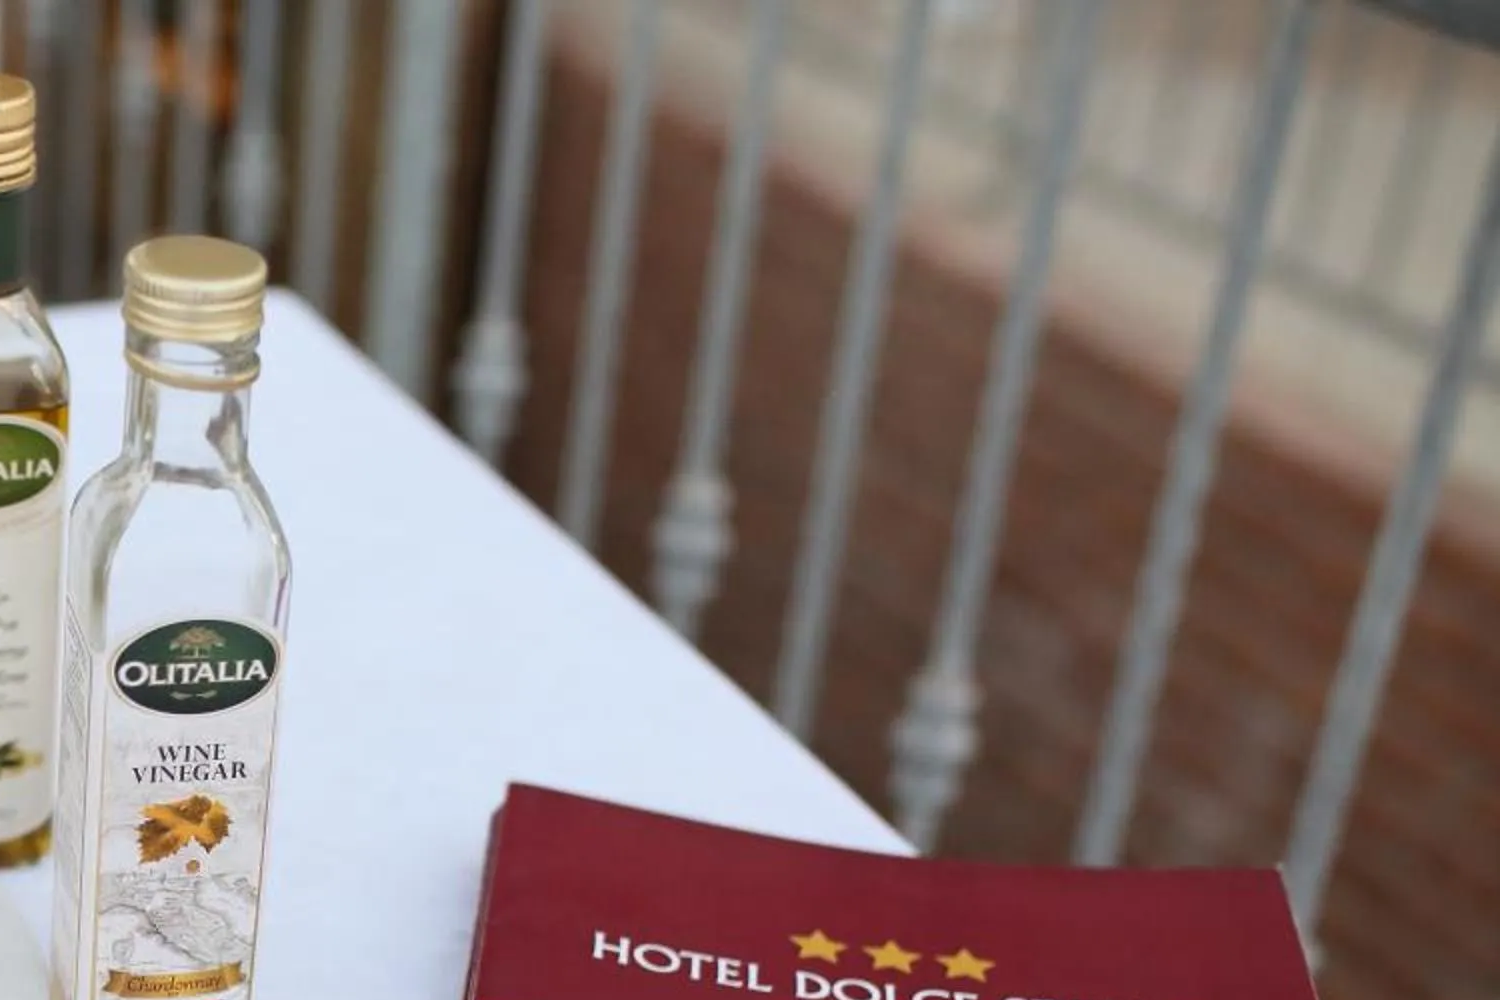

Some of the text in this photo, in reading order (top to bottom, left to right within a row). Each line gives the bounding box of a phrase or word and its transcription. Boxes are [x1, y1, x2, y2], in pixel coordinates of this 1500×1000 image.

[116, 659, 269, 688] OLITALIA
[157, 743, 228, 763] WINE
[132, 761, 247, 784] VINEGAR
[592, 930, 773, 994] HOTEL
[126, 974, 223, 993] Chardonnay
